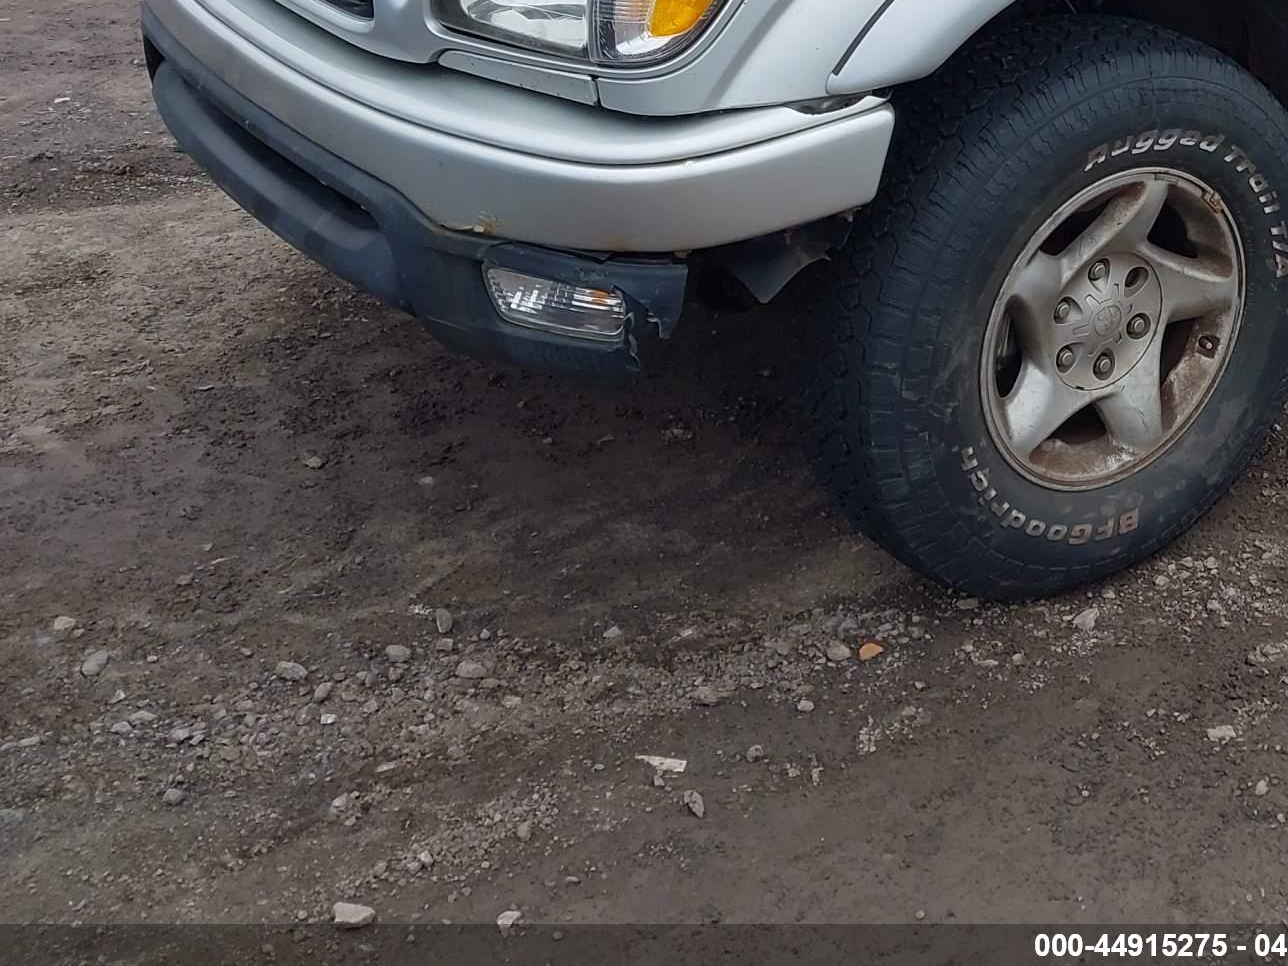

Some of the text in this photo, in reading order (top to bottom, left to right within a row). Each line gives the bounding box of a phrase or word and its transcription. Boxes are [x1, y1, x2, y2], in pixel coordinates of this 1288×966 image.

[1084, 128, 1226, 172] Rugged
[1223, 144, 1281, 214] Trail
[960, 446, 1140, 546] BFGoodrich
